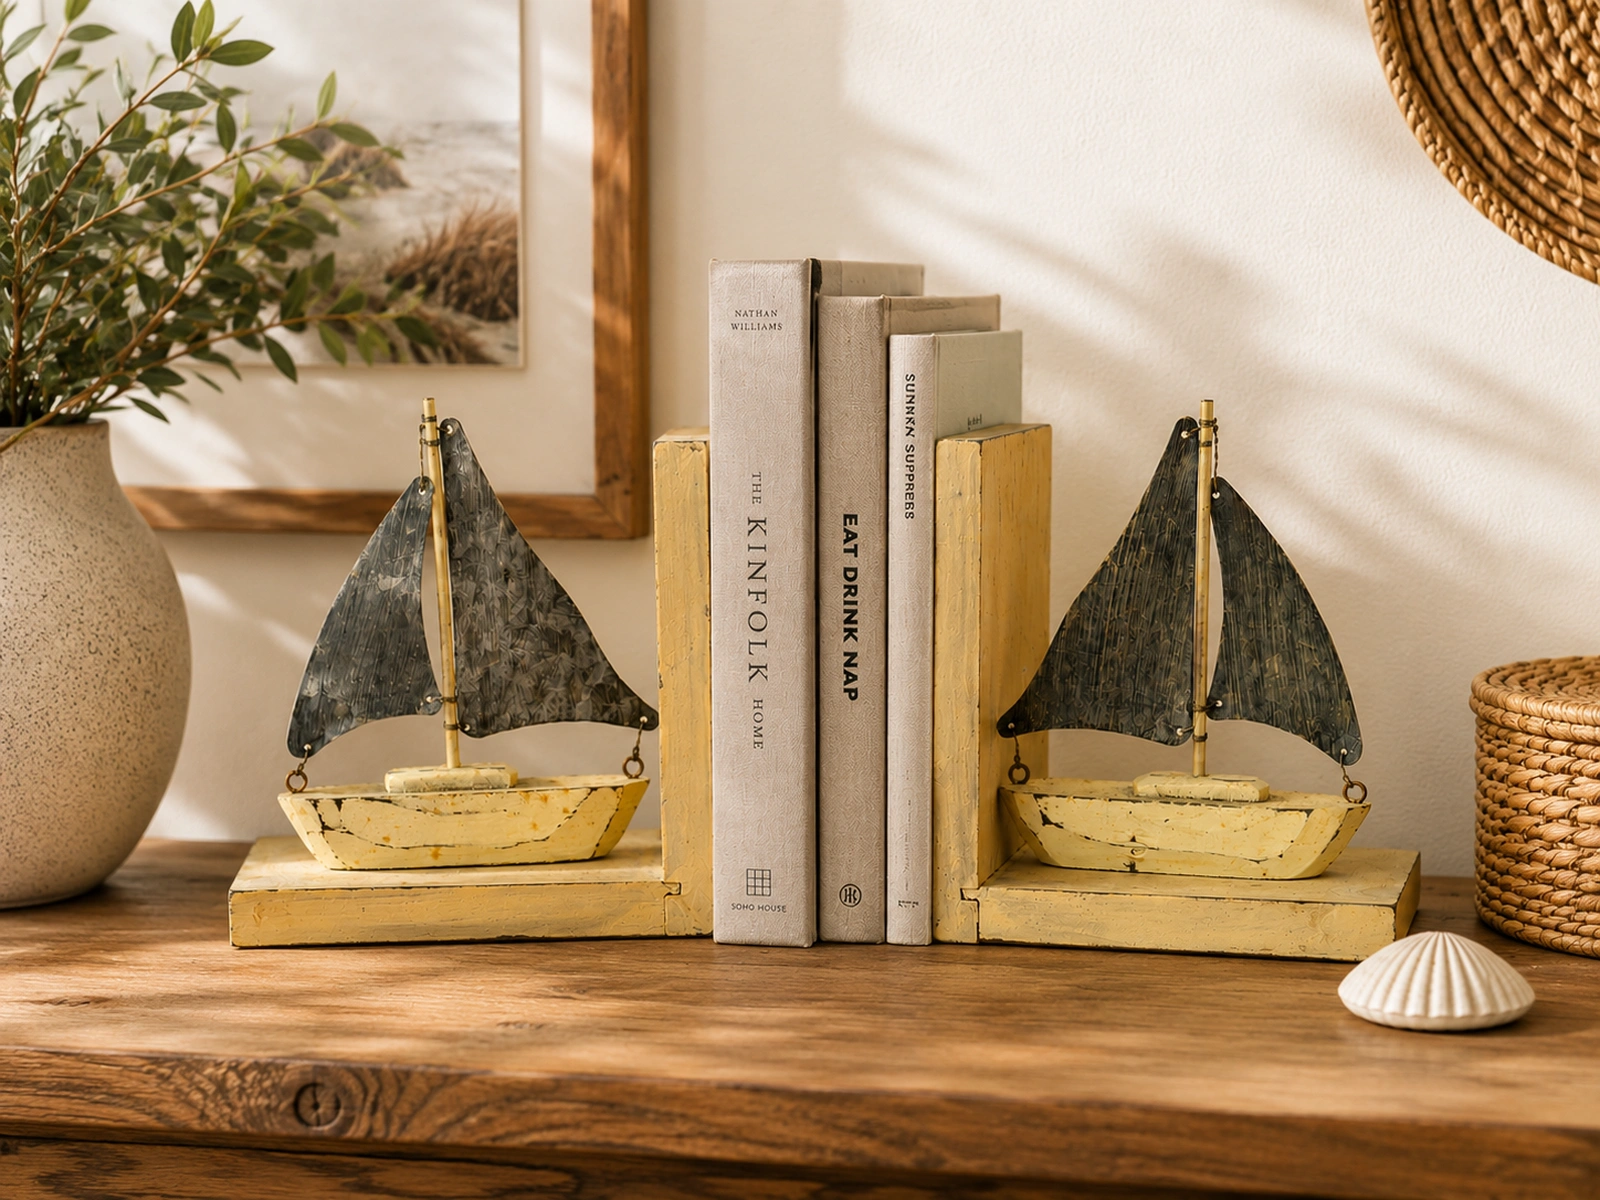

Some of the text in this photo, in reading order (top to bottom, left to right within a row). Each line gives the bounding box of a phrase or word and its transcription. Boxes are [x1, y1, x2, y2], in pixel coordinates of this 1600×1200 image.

[735, 309, 778, 318] NATHAN
[731, 322, 783, 331] WILLIAMS
[747, 471, 768, 750] THE KINFOLK HOME
[843, 513, 858, 701] EAT DRINK NAP
[731, 902, 787, 913] SOHO HOUSE
